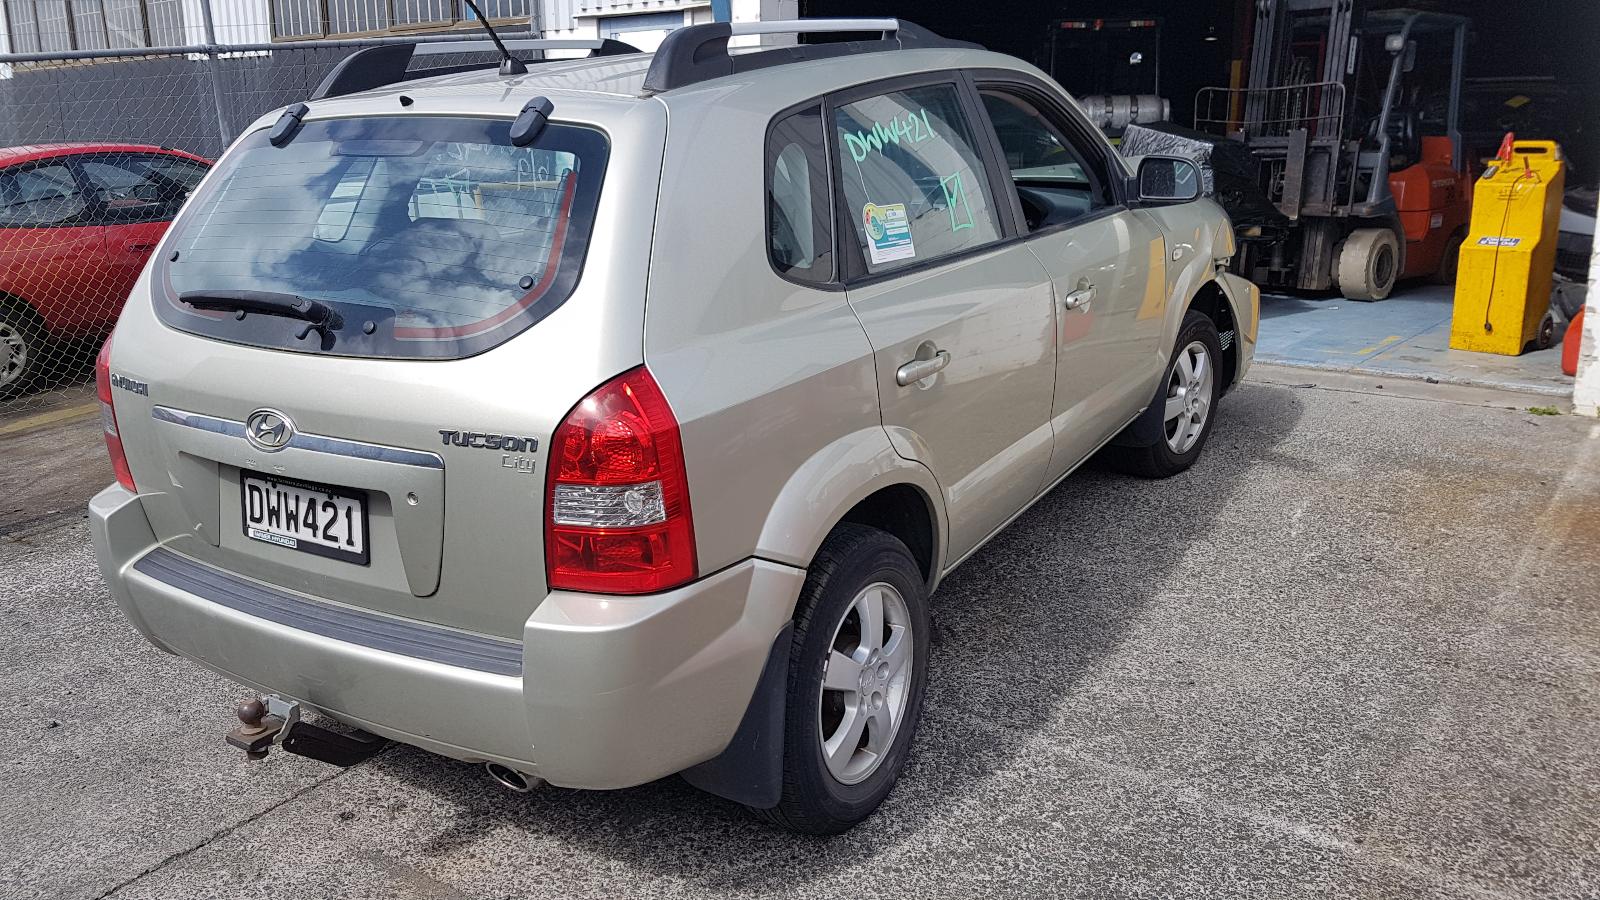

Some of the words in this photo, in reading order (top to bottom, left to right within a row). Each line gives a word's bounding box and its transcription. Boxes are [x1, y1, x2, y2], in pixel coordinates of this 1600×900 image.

[844, 108, 937, 162] DWW421
[438, 429, 539, 452] TUCSON
[502, 454, 536, 474] City
[248, 483, 355, 547] DWW421
